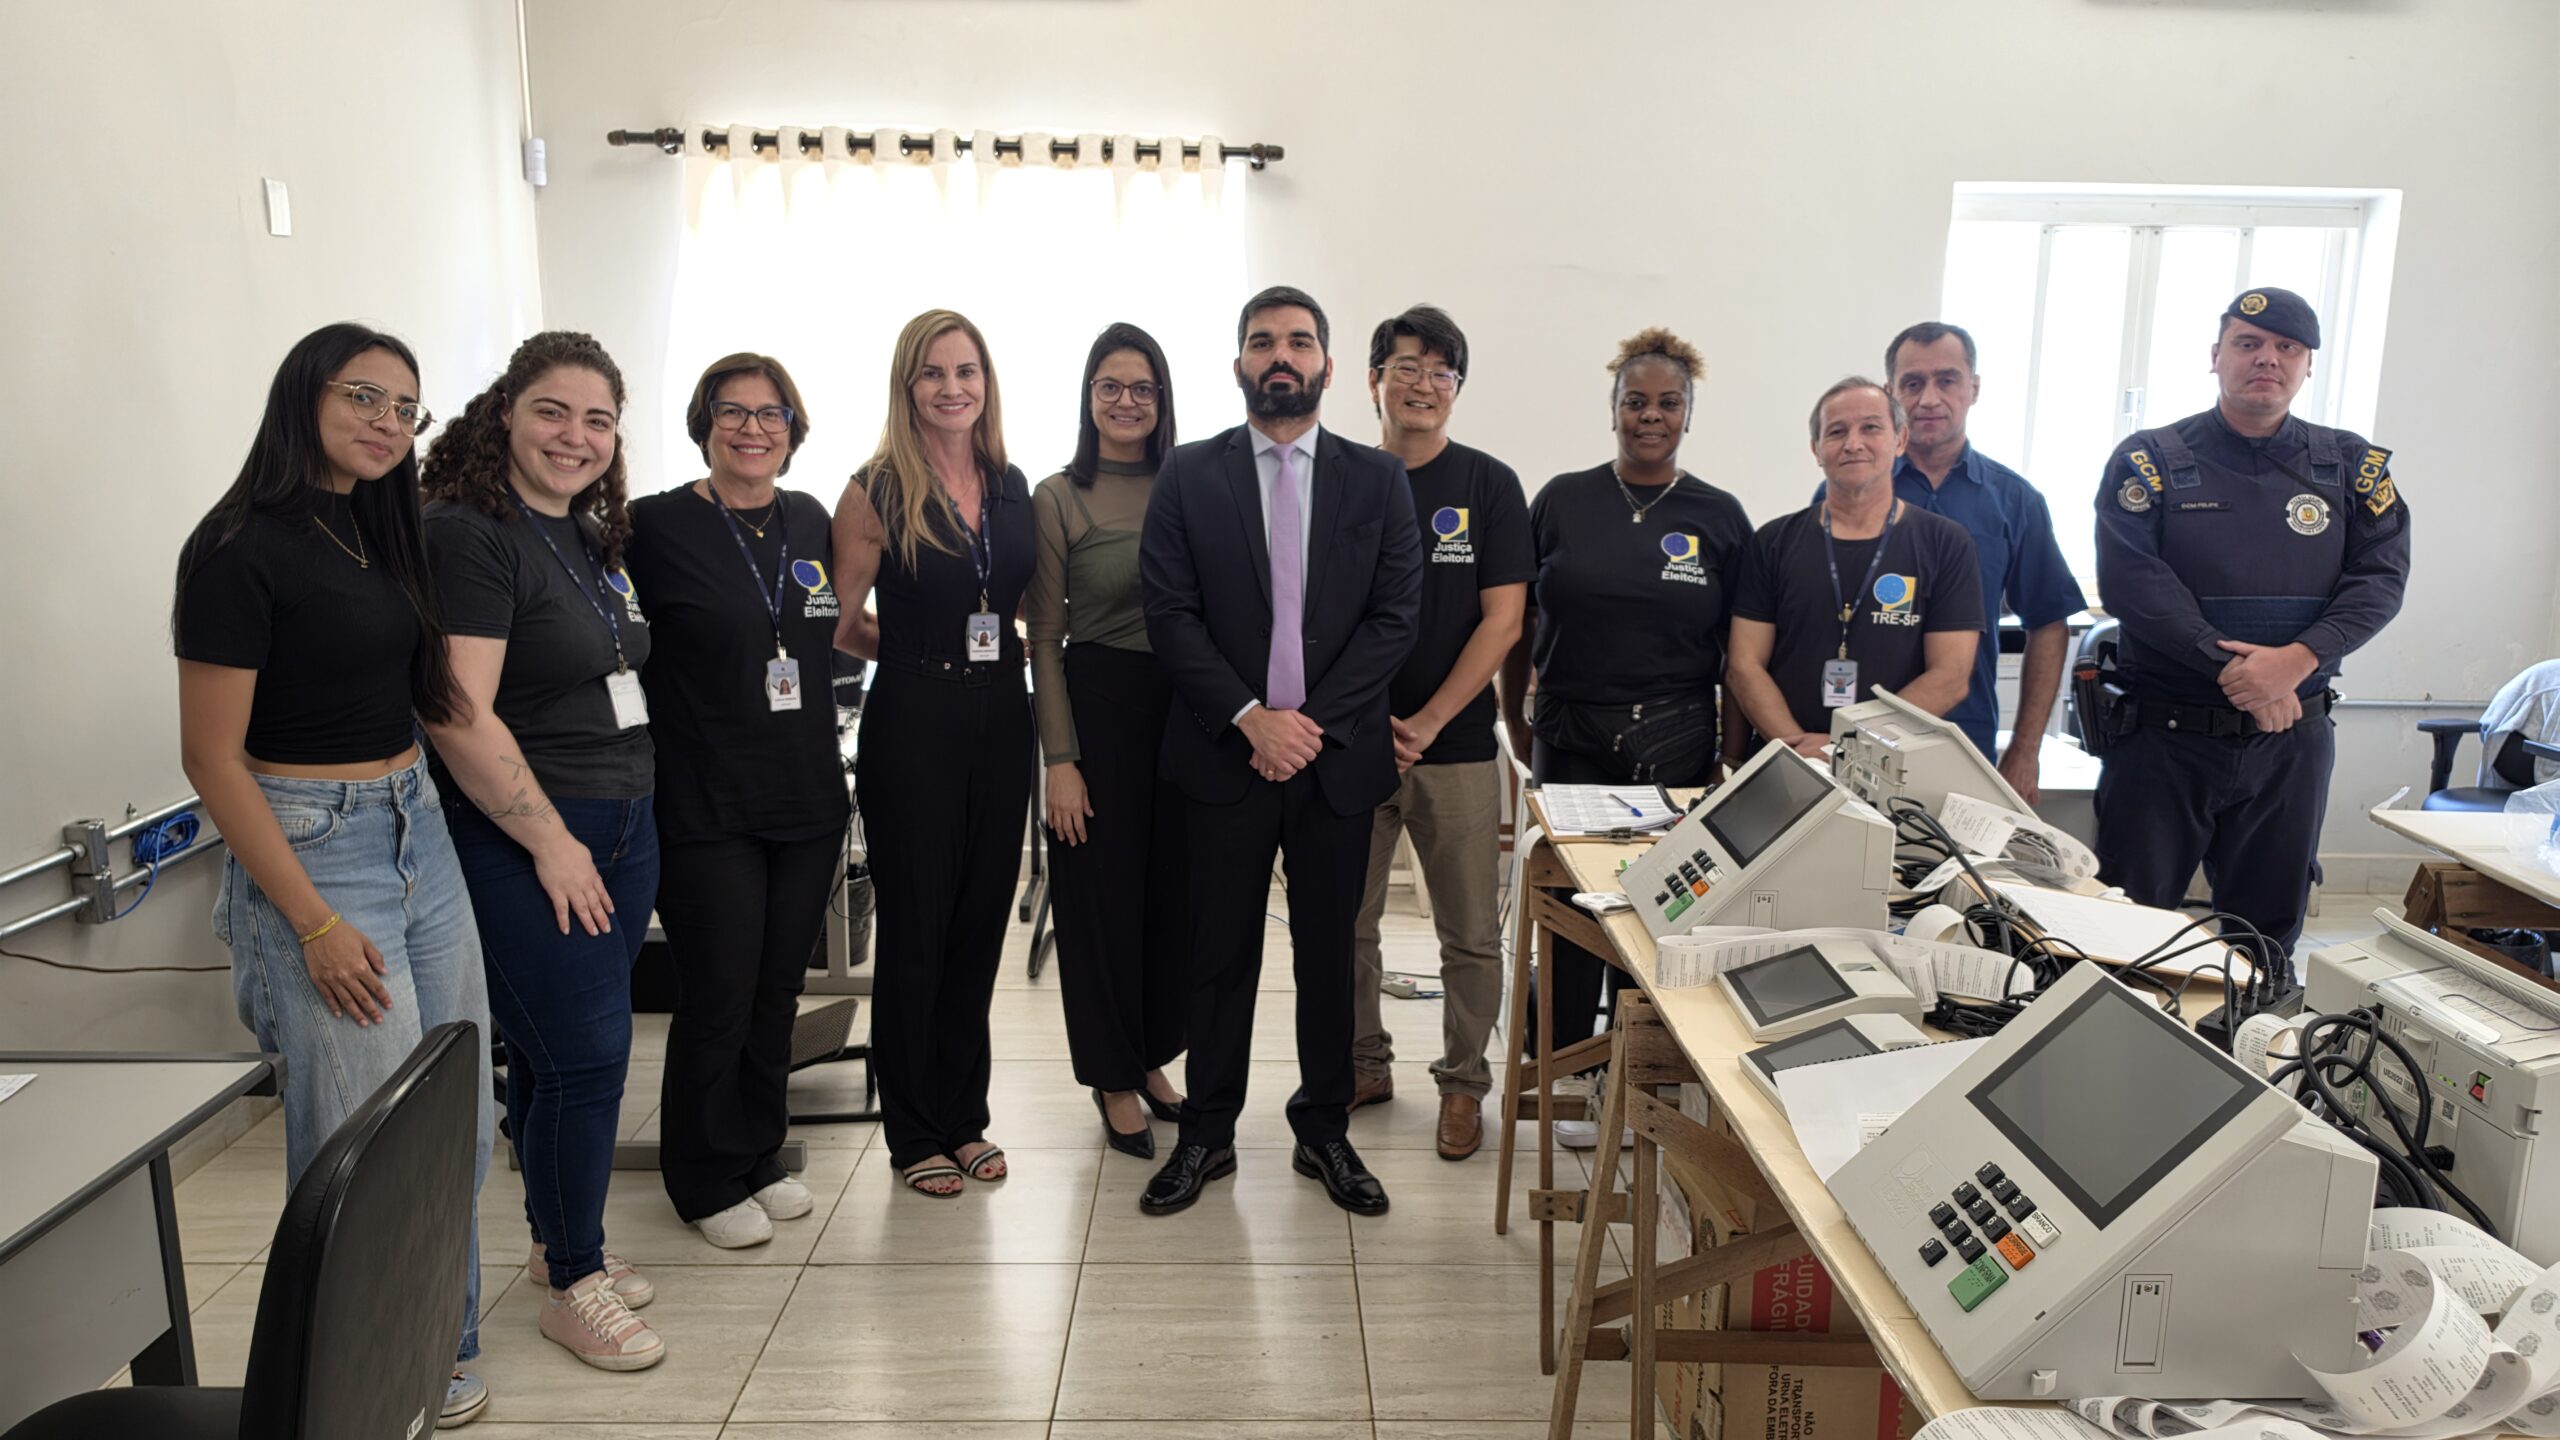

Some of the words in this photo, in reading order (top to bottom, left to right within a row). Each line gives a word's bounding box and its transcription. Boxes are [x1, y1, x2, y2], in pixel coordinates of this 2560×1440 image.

[2130, 451, 2163, 492] GCM
[2355, 449, 2387, 493] GCM
[1434, 542, 1473, 554] Justiça
[1431, 552, 1475, 563] Eleitoral
[1664, 561, 1705, 576] Justiça
[1661, 570, 1708, 586] Eleitoral
[1871, 611, 1921, 627] TRE-SP
[1982, 1163, 1992, 1172] 1
[1958, 1183, 1968, 1192] 4
[1996, 1178, 2007, 1189] 2
[1972, 1199, 1983, 1208] 5
[2012, 1195, 2022, 1205] 3
[1934, 1202, 1945, 1212] 7
[1948, 1219, 1959, 1229] 8
[1987, 1216, 1998, 1226] 6
[2031, 1211, 2053, 1234] BRANCO
[1924, 1239, 1935, 1249] 0
[1962, 1236, 1973, 1246] 9
[2006, 1231, 2029, 1257] CORRIGE
[1973, 1258, 1997, 1284] CONFIRMA
[1768, 1365, 1779, 1396] FORA
[1780, 1373, 1791, 1405] URNA
[1767, 1398, 1777, 1414] DA
[1803, 1411, 1815, 1436] NÃO
